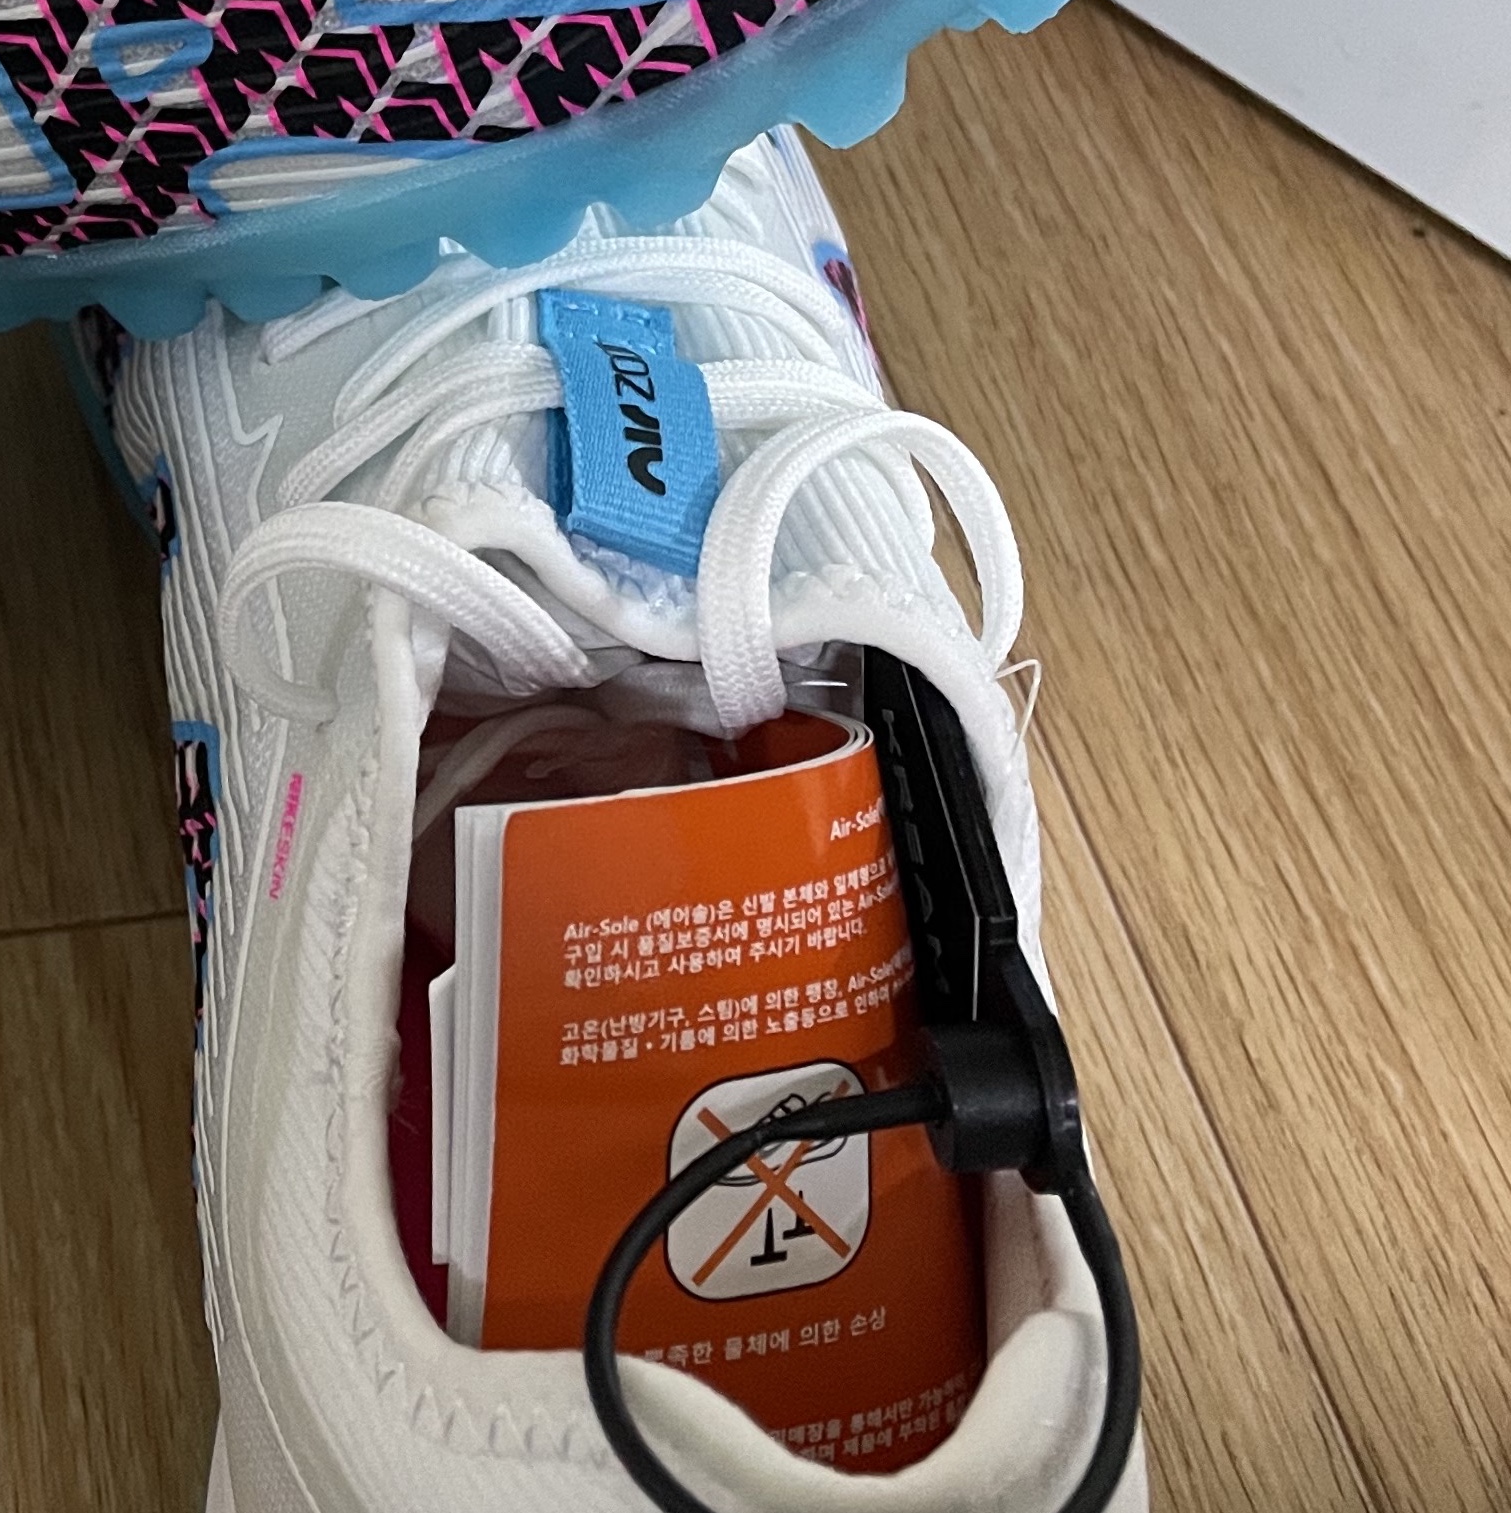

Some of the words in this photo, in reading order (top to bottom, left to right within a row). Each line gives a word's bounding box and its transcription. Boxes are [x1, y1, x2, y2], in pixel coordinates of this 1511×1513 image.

[564, 915, 639, 941] Air-Sole
[742, 891, 776, 916] 신발
[564, 940, 602, 966] 구입
[610, 938, 628, 959] 시
[756, 904, 822, 937] 명시되어
[827, 898, 854, 923] 있는
[564, 959, 660, 989] 확인하시고
[668, 945, 741, 975] 사용하여
[749, 934, 800, 963] 주시기
[807, 917, 867, 950] 바랍니다.
[765, 986, 799, 1011] 의한
[722, 1017, 758, 1041] 의한
[724, 1328, 790, 1361] 물체에
[798, 1318, 841, 1347] 의한
[849, 1306, 886, 1336] 손상
